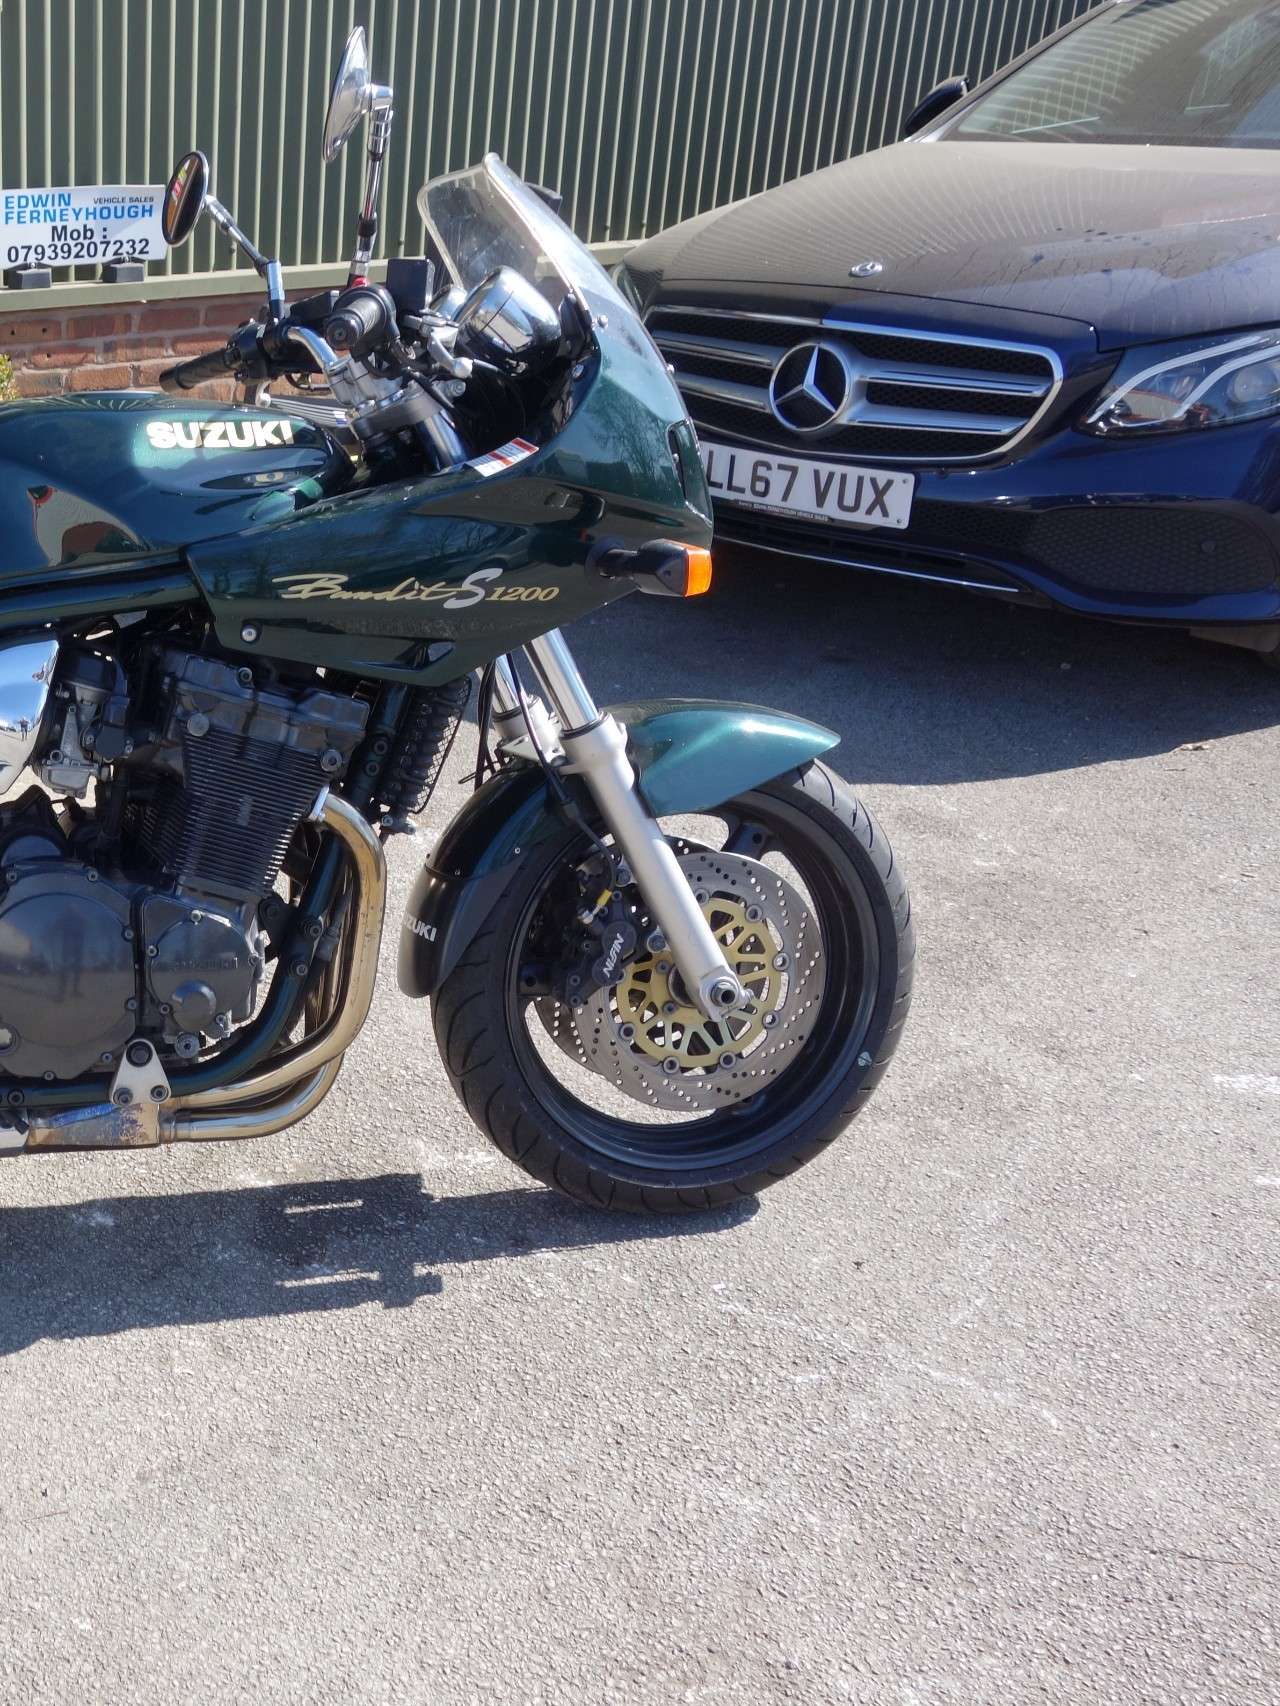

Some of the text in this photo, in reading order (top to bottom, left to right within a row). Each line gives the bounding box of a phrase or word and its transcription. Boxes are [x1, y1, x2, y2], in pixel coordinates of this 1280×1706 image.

[4, 192, 72, 210] EDWIN
[93, 196, 126, 204] VEHICLE
[4, 204, 154, 225] FERNEYHOUGH
[7, 238, 150, 263] 07939207232
[146, 420, 295, 448] SUZUKI
[706, 450, 800, 502] LL67
[813, 469, 895, 518] VUX
[272, 568, 560, 609] Bandit S 1200
